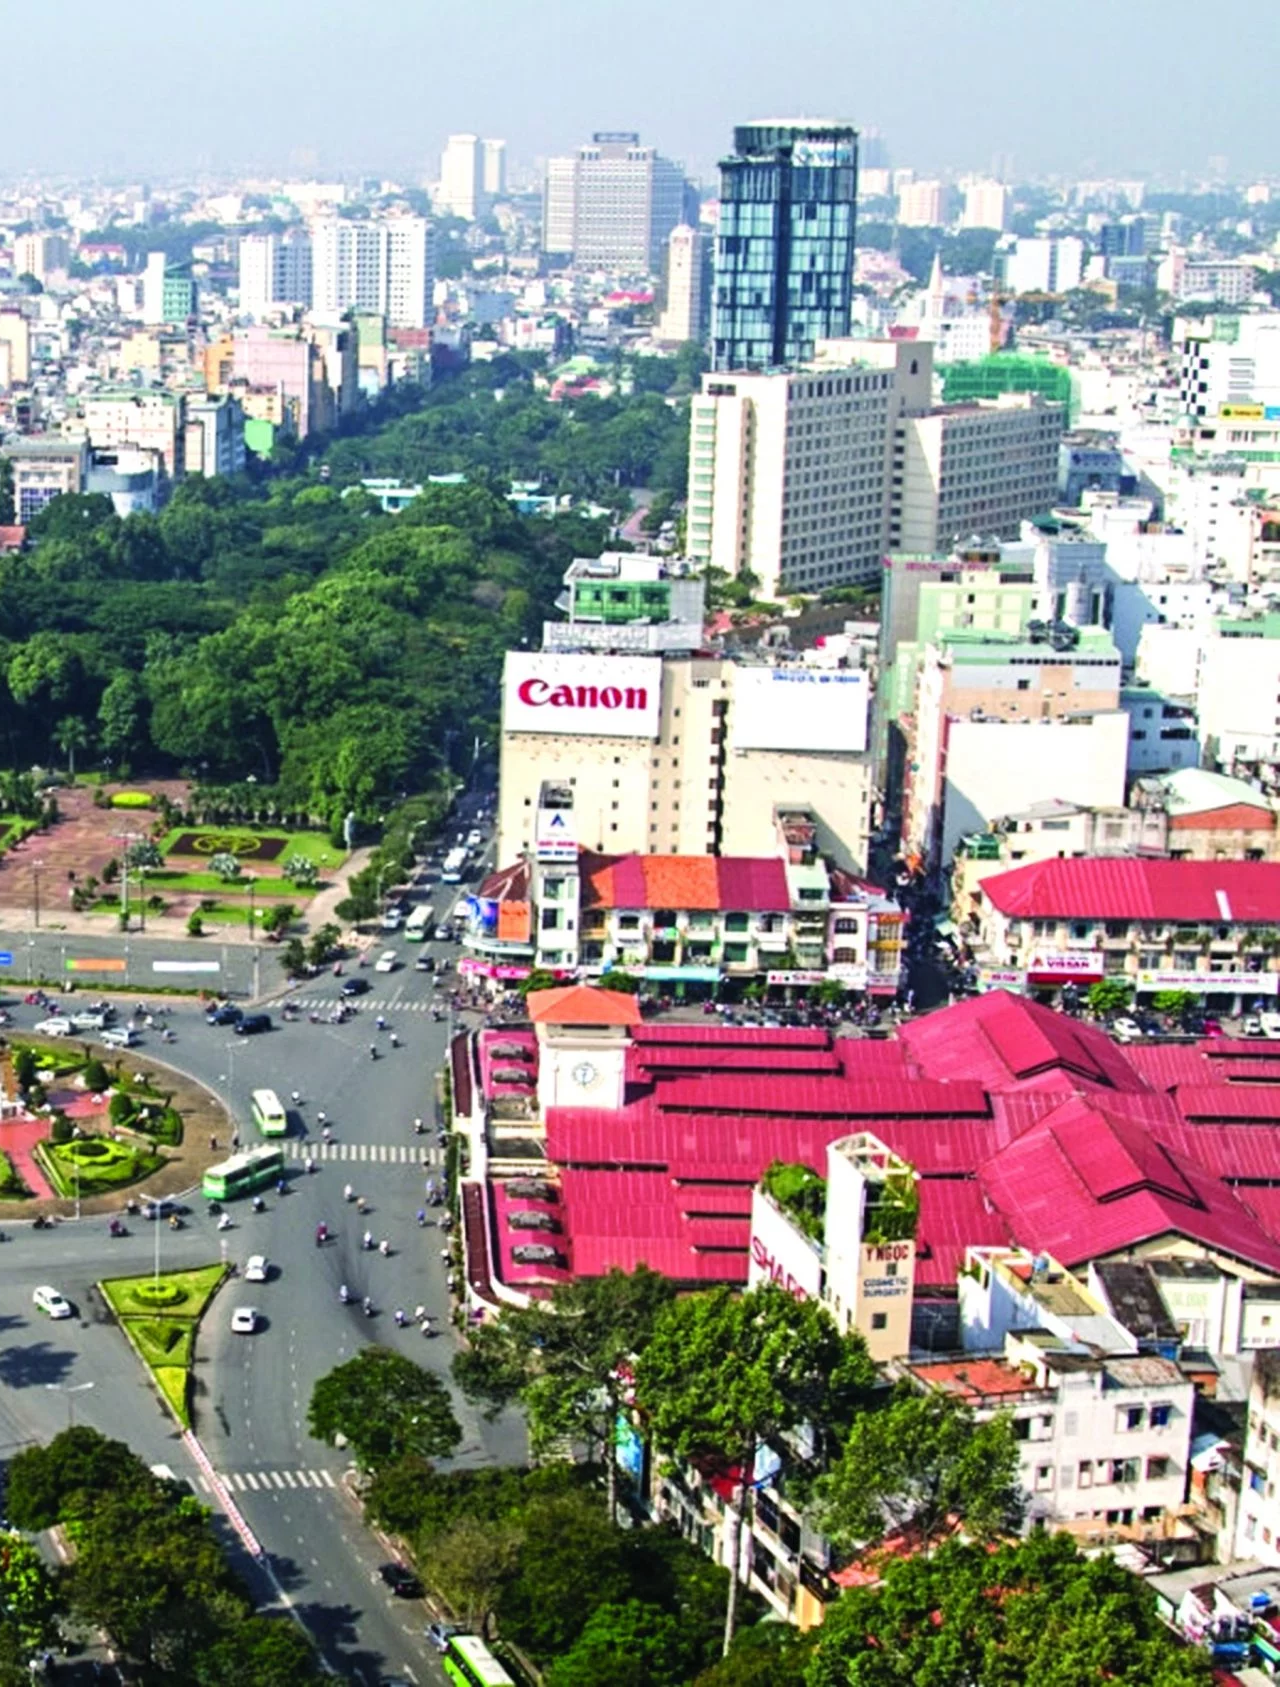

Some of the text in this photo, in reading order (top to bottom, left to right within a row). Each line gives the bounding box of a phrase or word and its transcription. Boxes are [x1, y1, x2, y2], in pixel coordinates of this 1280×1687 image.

[518, 678, 648, 710] Canon
[863, 1277, 909, 1287] COSMETIC
[863, 1288, 908, 1298] SURGERY
